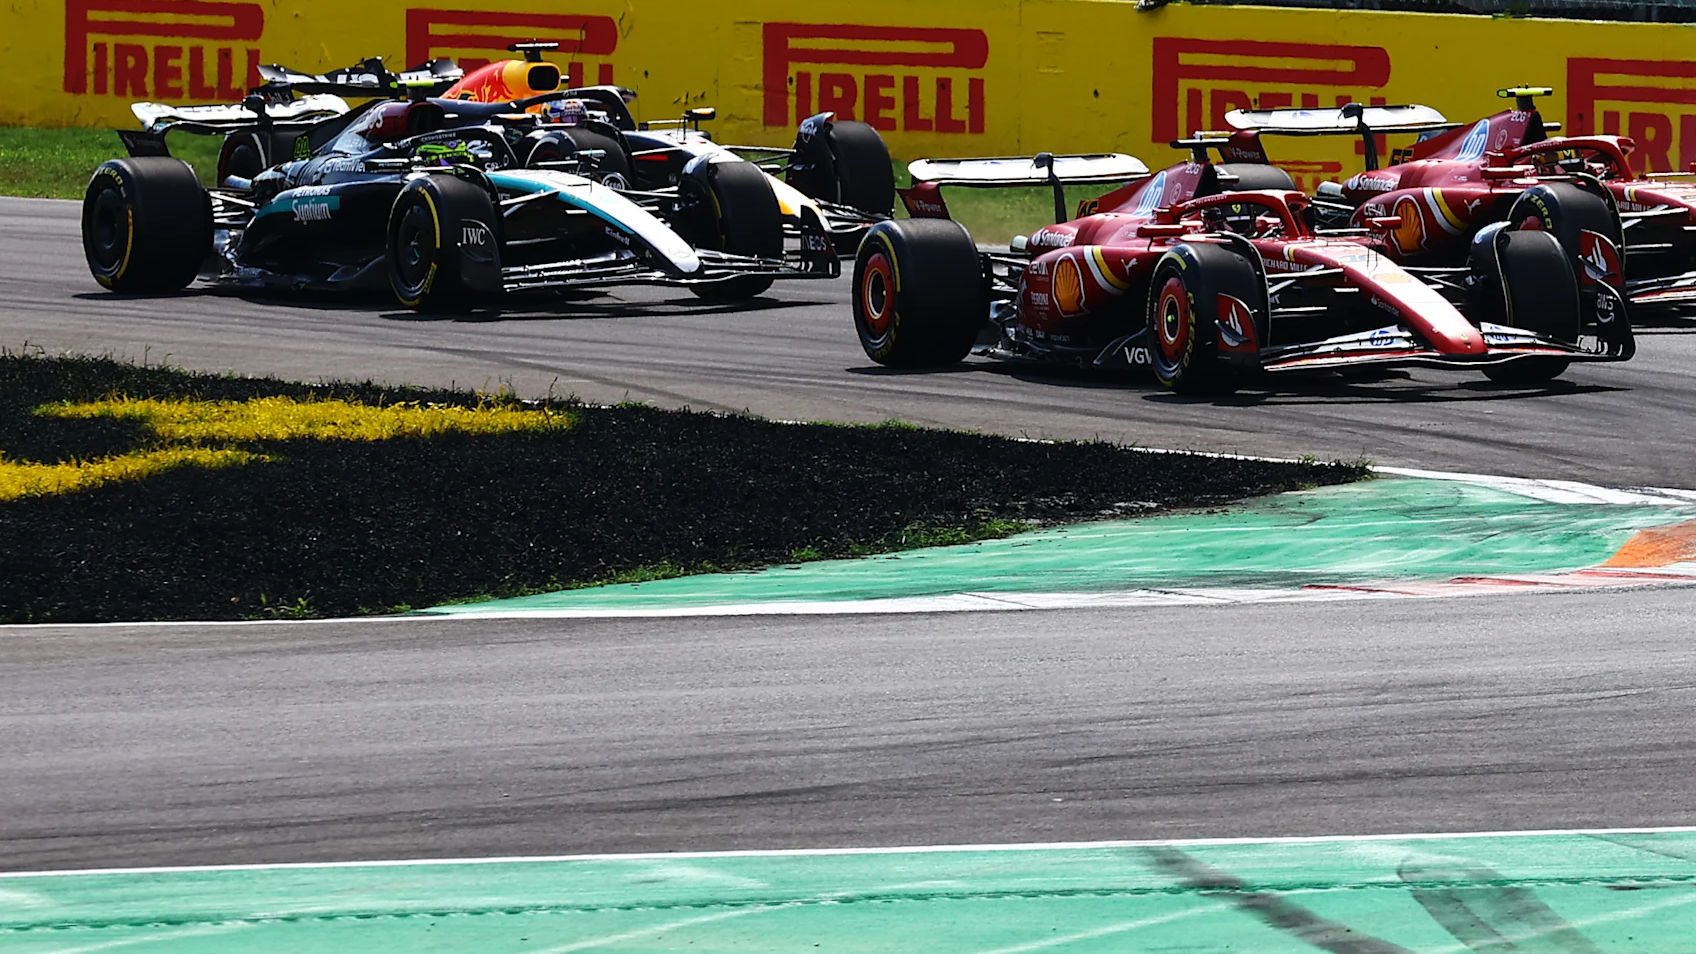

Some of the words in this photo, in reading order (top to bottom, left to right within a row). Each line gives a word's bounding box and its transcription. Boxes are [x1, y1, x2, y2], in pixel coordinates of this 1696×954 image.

[763, 21, 989, 134] PIRELLI
[1358, 174, 1399, 191] Santander
[292, 198, 332, 226] Syntium
[913, 199, 941, 213] V-Power
[462, 227, 487, 246] IWC
[1040, 229, 1075, 246] Santander
